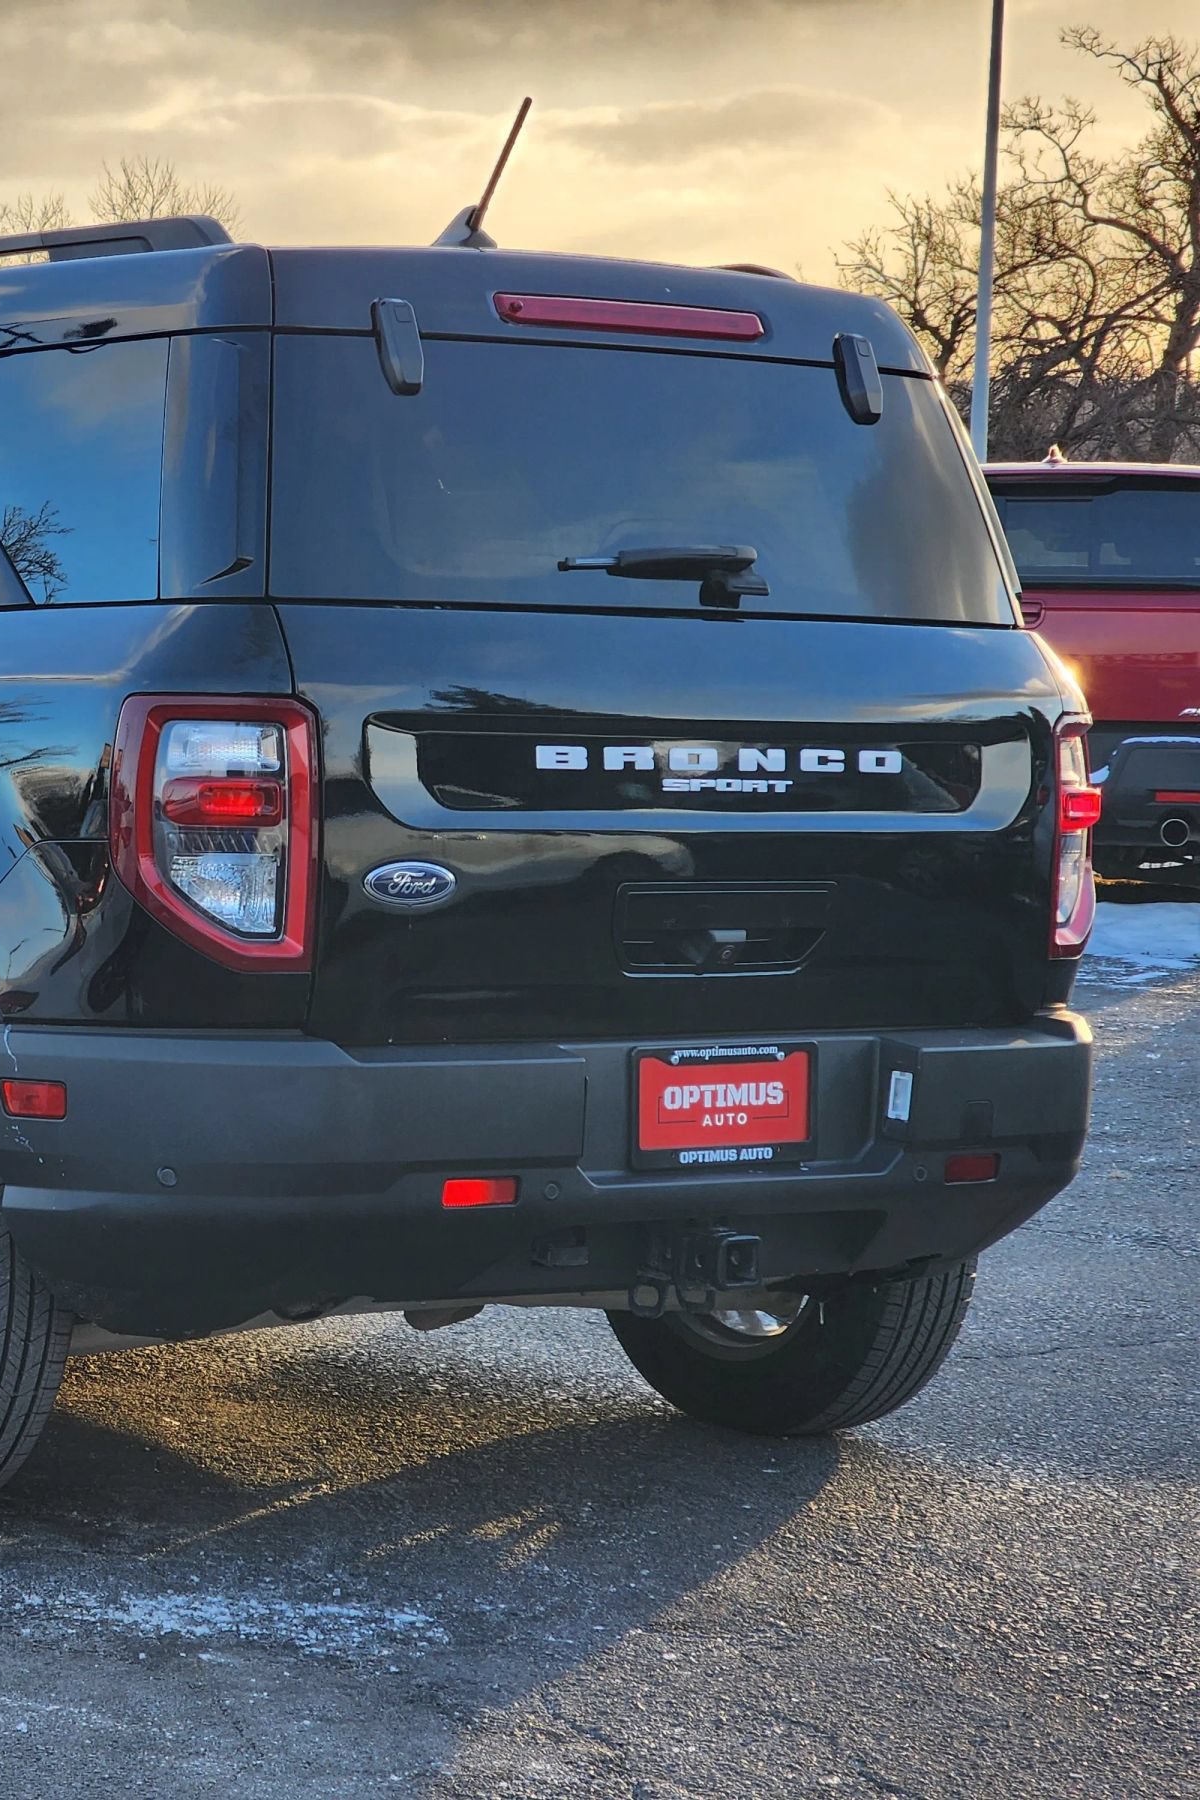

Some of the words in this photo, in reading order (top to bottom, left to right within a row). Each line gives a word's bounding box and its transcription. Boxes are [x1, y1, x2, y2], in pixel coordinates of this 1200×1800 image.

[535, 745, 902, 773] BRONCO
[662, 778, 793, 793] SPORT
[387, 871, 437, 894] Ford
[673, 1046, 778, 1060] www.optimusauto.com
[663, 1082, 784, 1110] OPTIMUS
[702, 1113, 748, 1126] AUTO
[679, 1150, 738, 1164] OPTIMUS
[739, 1147, 773, 1160] AUTO
